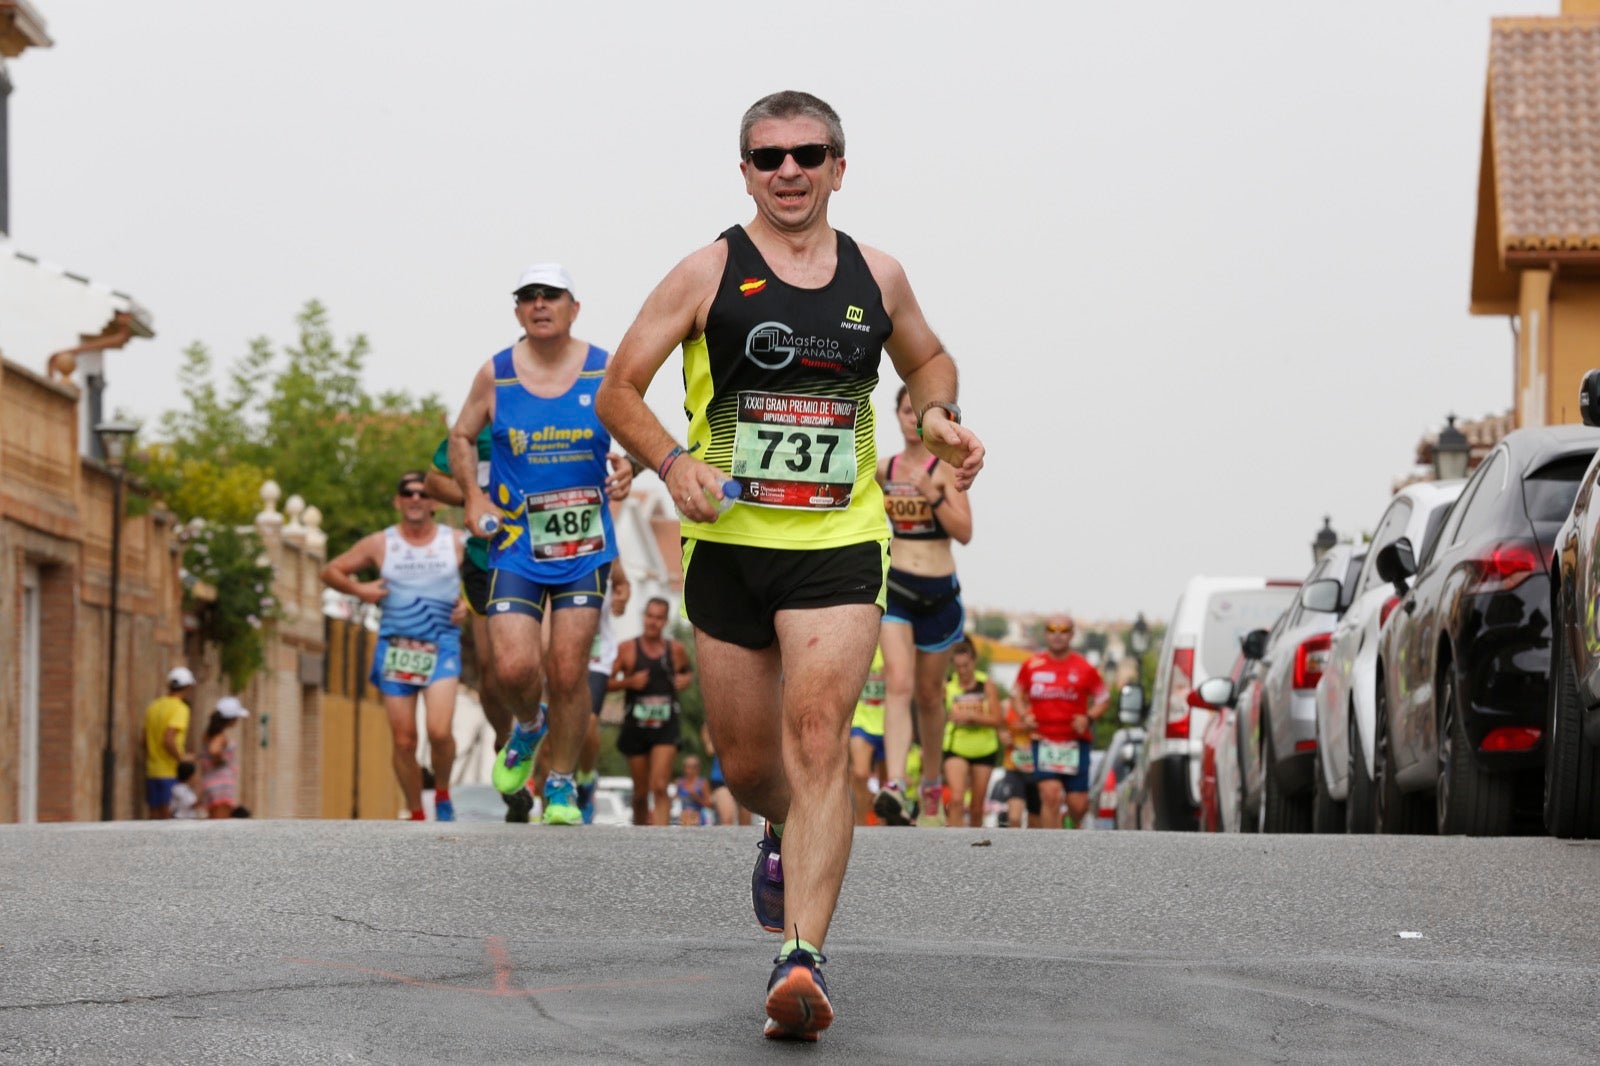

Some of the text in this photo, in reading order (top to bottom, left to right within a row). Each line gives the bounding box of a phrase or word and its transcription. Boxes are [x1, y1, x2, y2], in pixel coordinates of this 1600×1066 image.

[848, 307, 861, 319] IN
[841, 321, 871, 333] INVERSE
[782, 335, 839, 350] MasFoto
[801, 358, 843, 371] Running
[744, 396, 852, 416] XXXII GRAN PREMIO DE FONDO
[763, 412, 835, 426] DIPUTACIÓN CRUZCAMPO
[531, 426, 594, 443] olimpo
[530, 442, 570, 451] deportes
[758, 430, 839, 474] 737
[528, 455, 550, 465] TRAIL
[559, 453, 594, 463] RUNNING
[885, 500, 928, 517] 2007
[545, 509, 592, 537] 486
[390, 652, 433, 673] 1059
